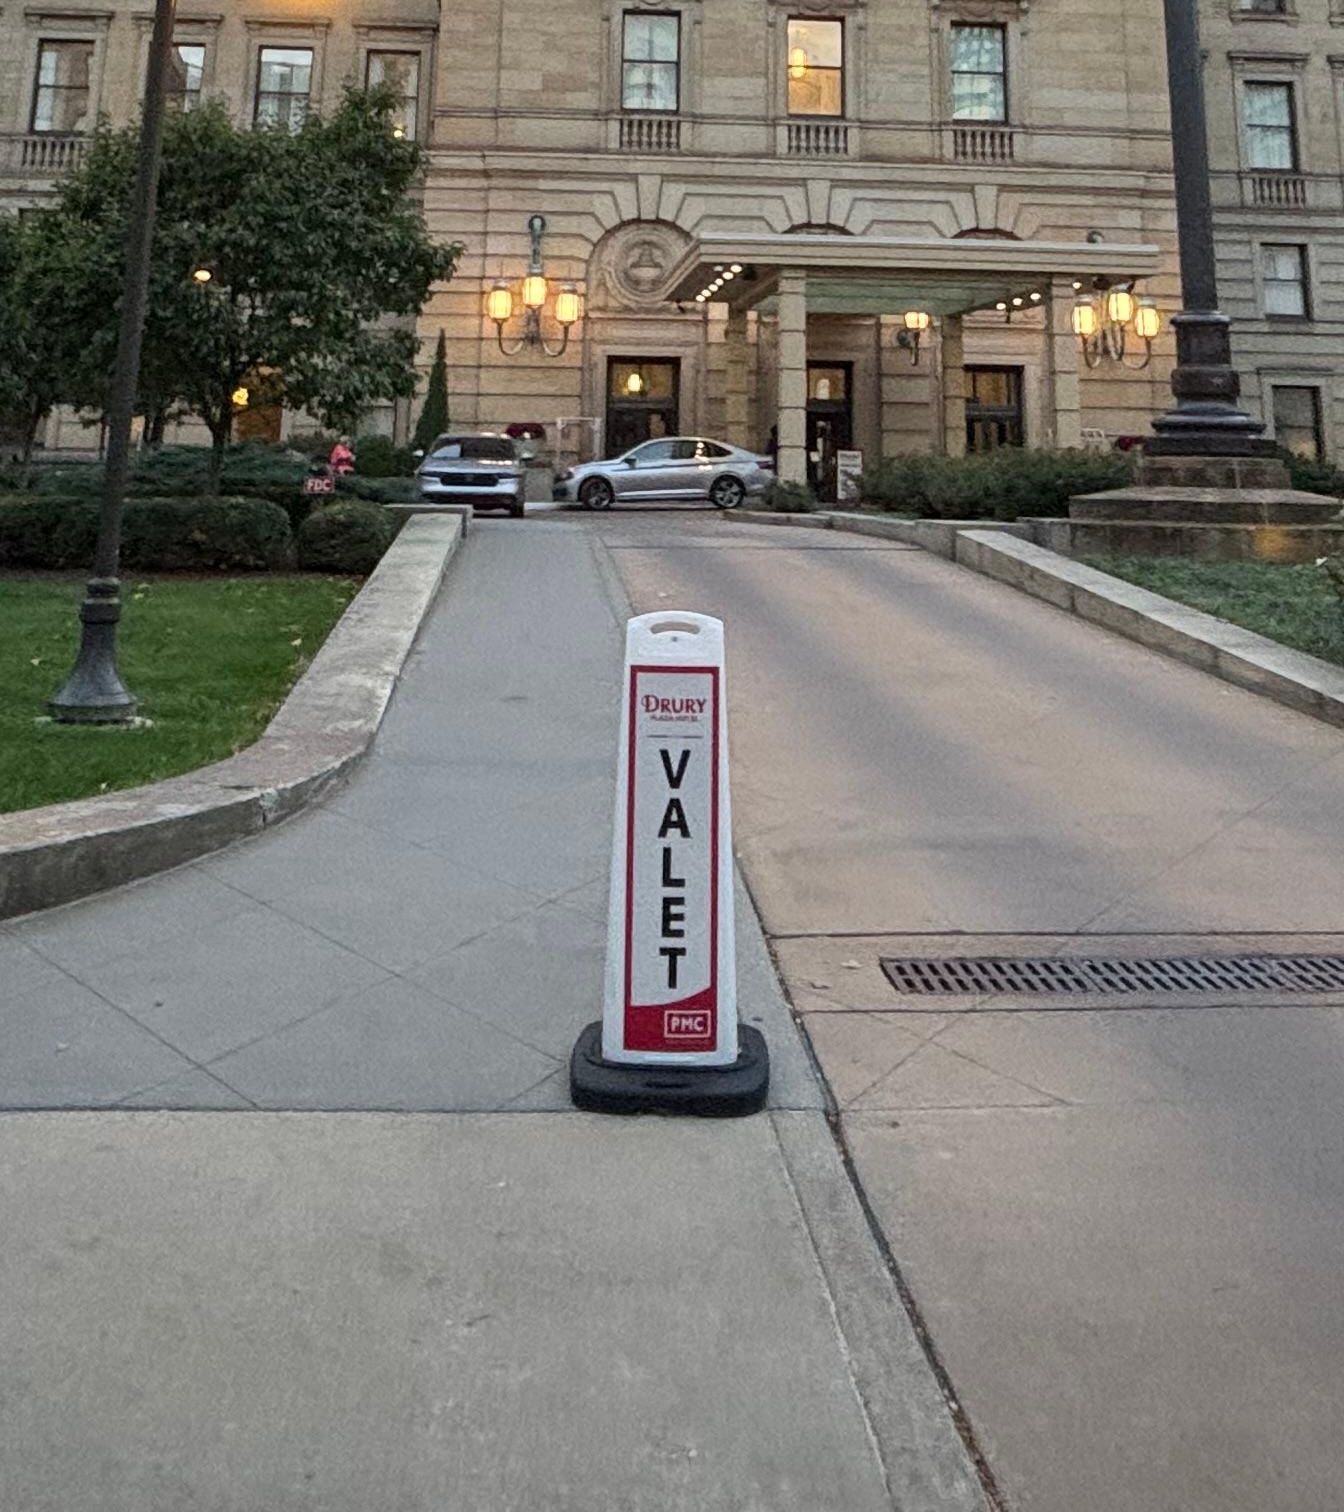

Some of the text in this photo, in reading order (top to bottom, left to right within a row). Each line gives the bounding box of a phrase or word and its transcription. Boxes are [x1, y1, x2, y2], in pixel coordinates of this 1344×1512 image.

[307, 478, 332, 491] FDC
[641, 694, 707, 713] DRURY
[658, 749, 692, 989] VALET
[671, 1016, 705, 1032] PMC
